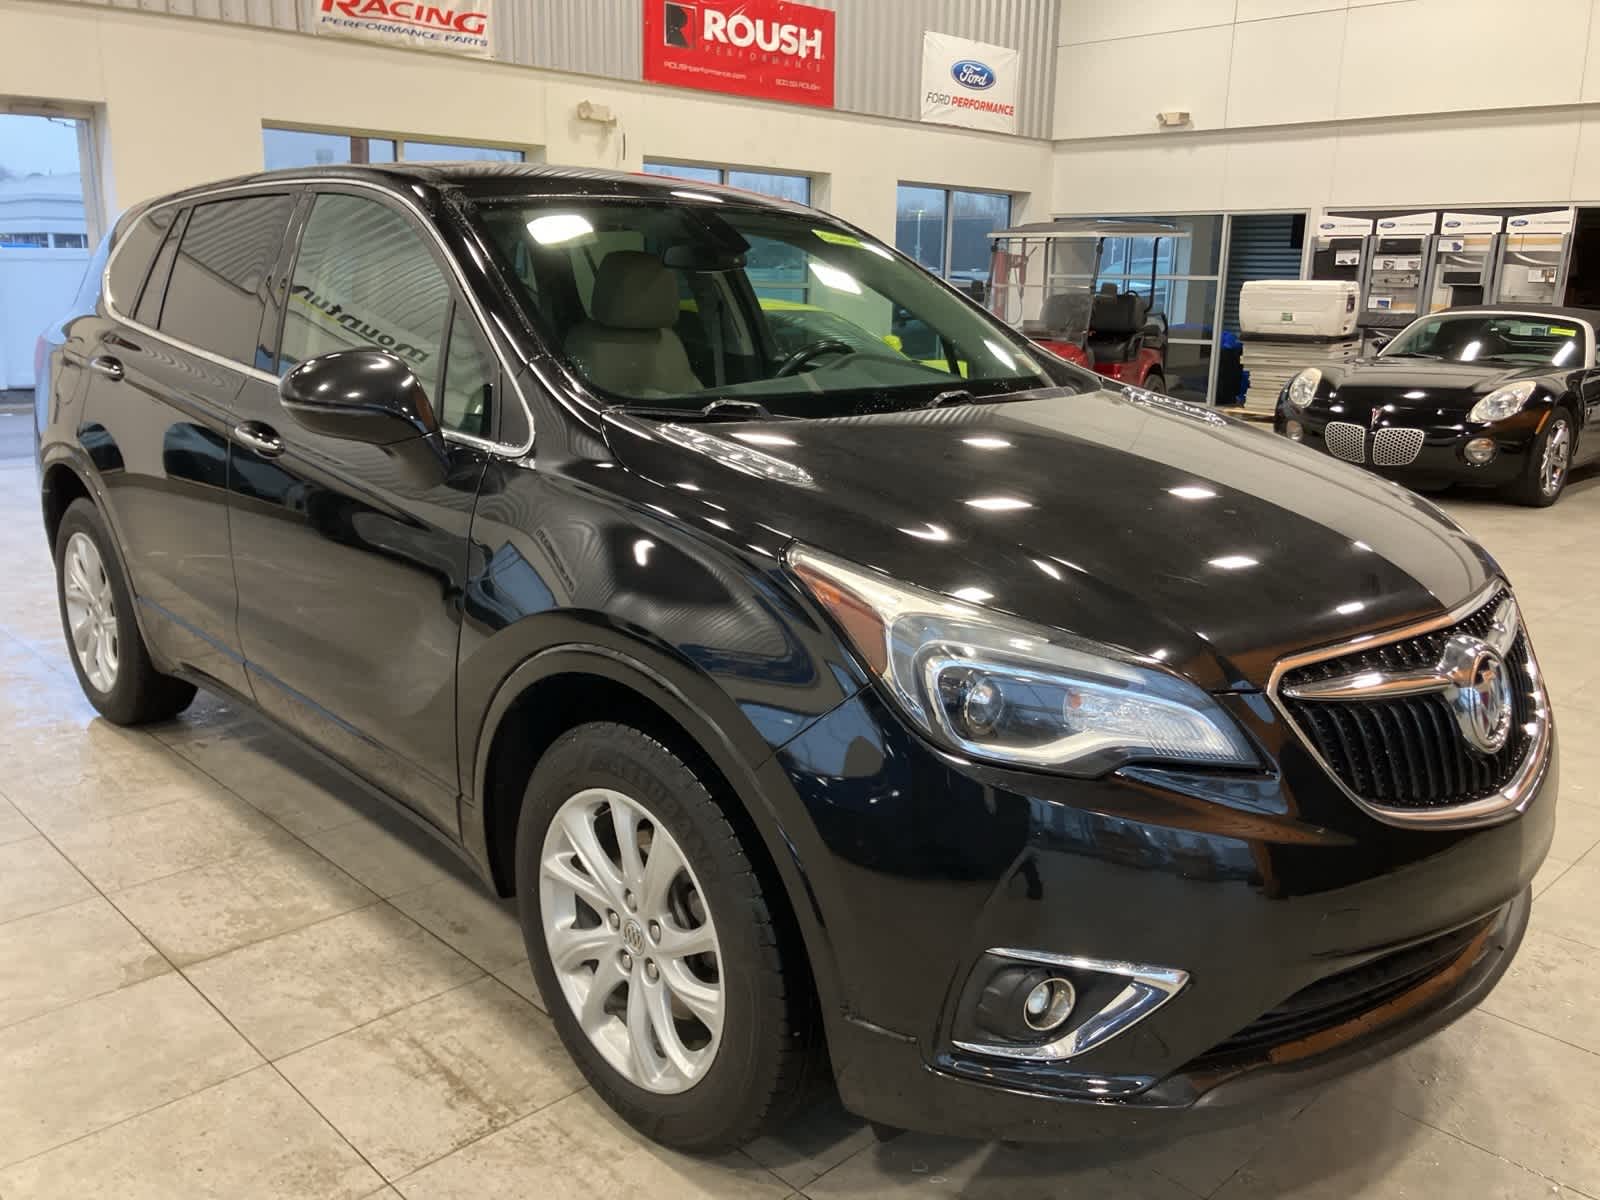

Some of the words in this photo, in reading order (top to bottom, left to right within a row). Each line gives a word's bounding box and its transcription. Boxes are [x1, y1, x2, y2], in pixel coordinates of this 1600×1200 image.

[321, 0, 488, 35] RACING
[321, 16, 440, 42] PERFORMANCE
[445, 35, 489, 47] PARTS
[703, 8, 823, 61] ROUSH
[704, 44, 821, 72] PERFORMANCE
[958, 63, 990, 87] Ford
[926, 92, 951, 105] FORD
[951, 96, 1015, 116] PERFORMANCE
